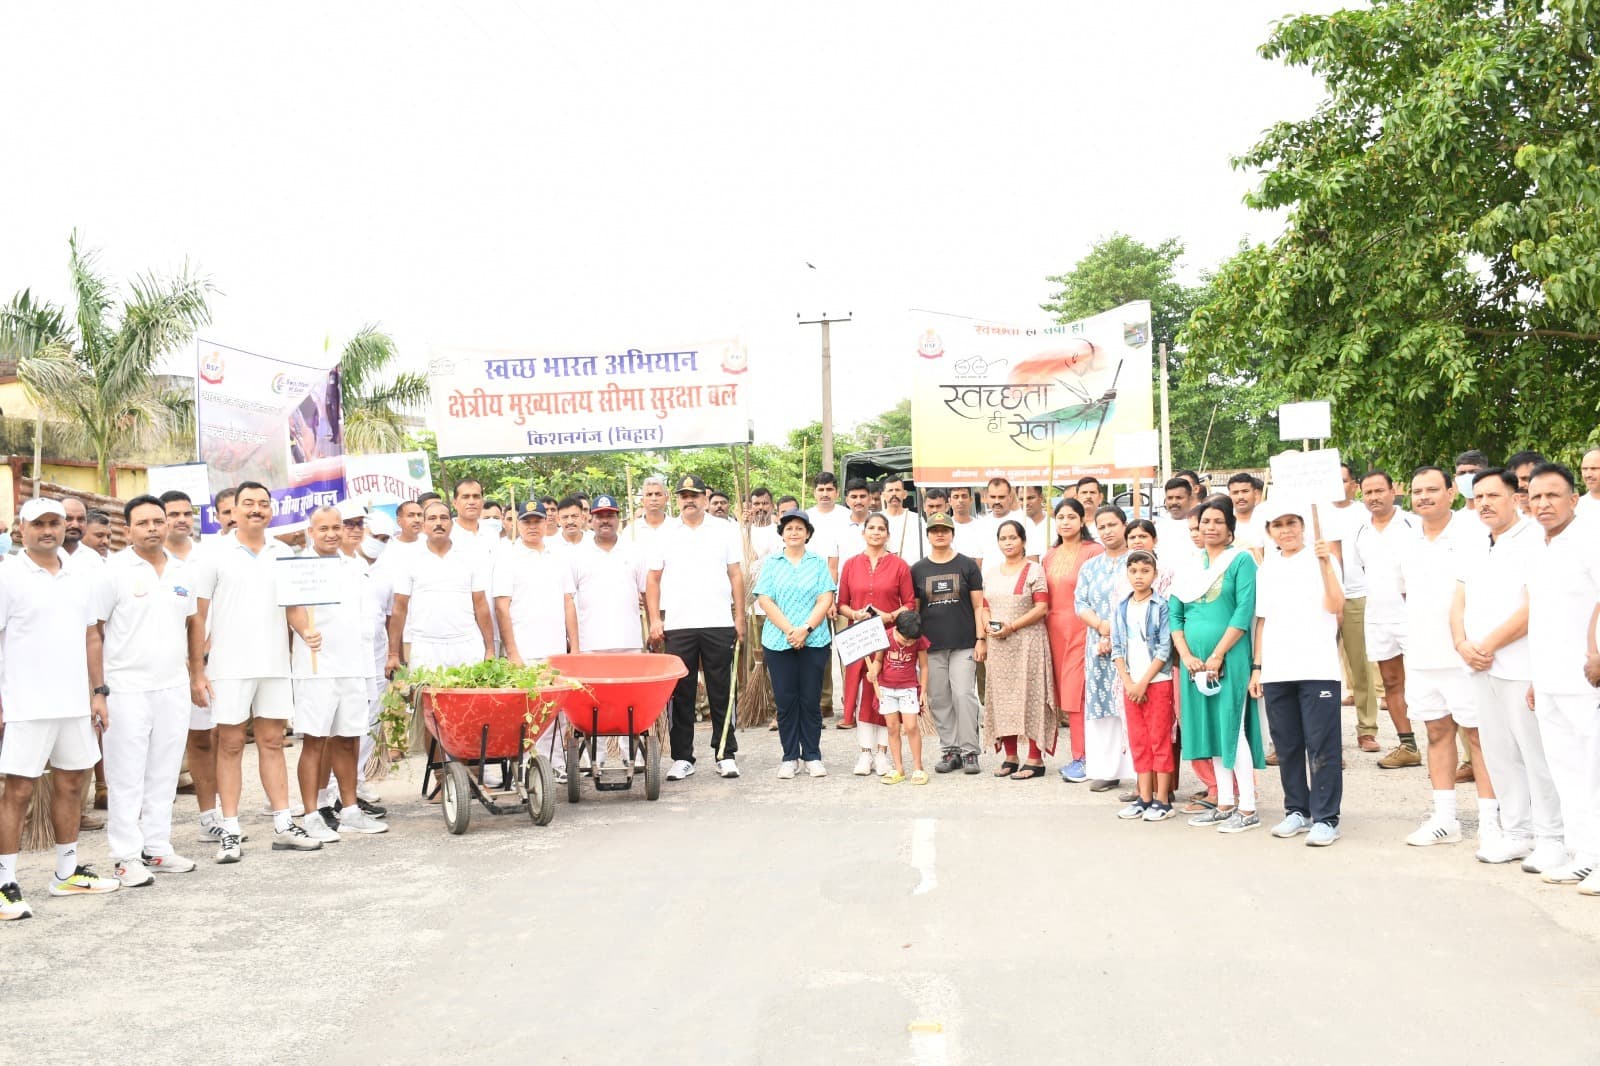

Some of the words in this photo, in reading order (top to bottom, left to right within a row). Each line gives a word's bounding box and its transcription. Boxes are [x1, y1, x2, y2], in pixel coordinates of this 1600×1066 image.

[485, 358, 537, 379] स्वच्छ
[543, 355, 598, 378] भारत
[605, 348, 698, 375] अभियान
[448, 387, 503, 418] क्षेत्रीय
[509, 390, 593, 426] मुख्यालय
[598, 382, 646, 412] सीमा
[650, 385, 702, 419] सुरक्षा
[708, 383, 739, 407] बल
[939, 383, 1055, 419] स्वच्छता
[527, 427, 604, 446] किशनगंज
[608, 424, 664, 445] (बिहार)
[987, 410, 1006, 433] ही
[1008, 413, 1060, 452] सेवा
[352, 474, 381, 497] प्रथम
